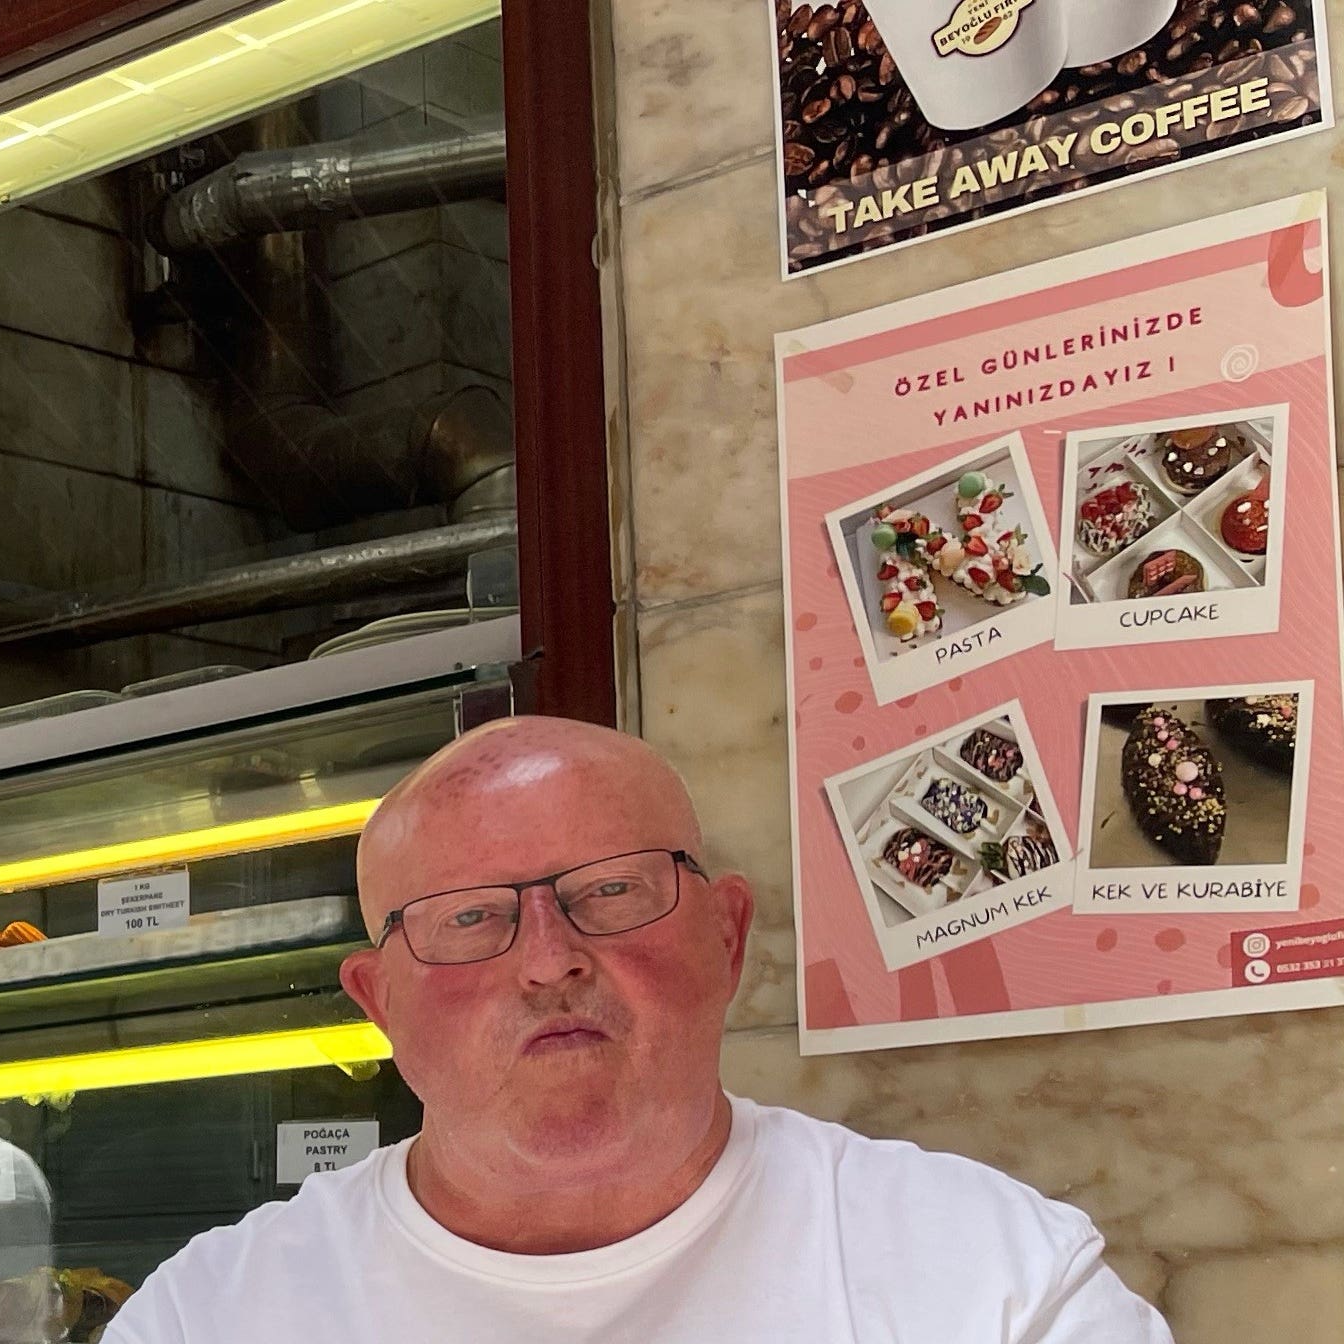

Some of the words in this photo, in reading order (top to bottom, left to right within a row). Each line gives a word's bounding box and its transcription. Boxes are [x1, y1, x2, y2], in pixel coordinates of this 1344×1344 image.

[829, 175, 940, 234] TAKE
[949, 132, 1078, 200] AWAY
[1090, 77, 1271, 155] COFFEE
[894, 366, 965, 397] ÖZEL
[980, 306, 1203, 376] GÜNLERİNİZDE
[933, 360, 1152, 427] YANINIZDAYIZ
[1118, 603, 1220, 629] CUPCAKE
[934, 626, 1003, 665] PASTA
[1092, 882, 1132, 901] KEK
[1142, 881, 1169, 900] VE
[1177, 879, 1288, 900] KURABİYE
[125, 918, 143, 930] 100
[145, 916, 160, 927] TL
[915, 902, 1009, 948] MAGNUM
[1013, 885, 1053, 912] KEK
[303, 1127, 350, 1140] POĞAÇA
[305, 1144, 348, 1156] PASTRY
[324, 1161, 337, 1172] TL
